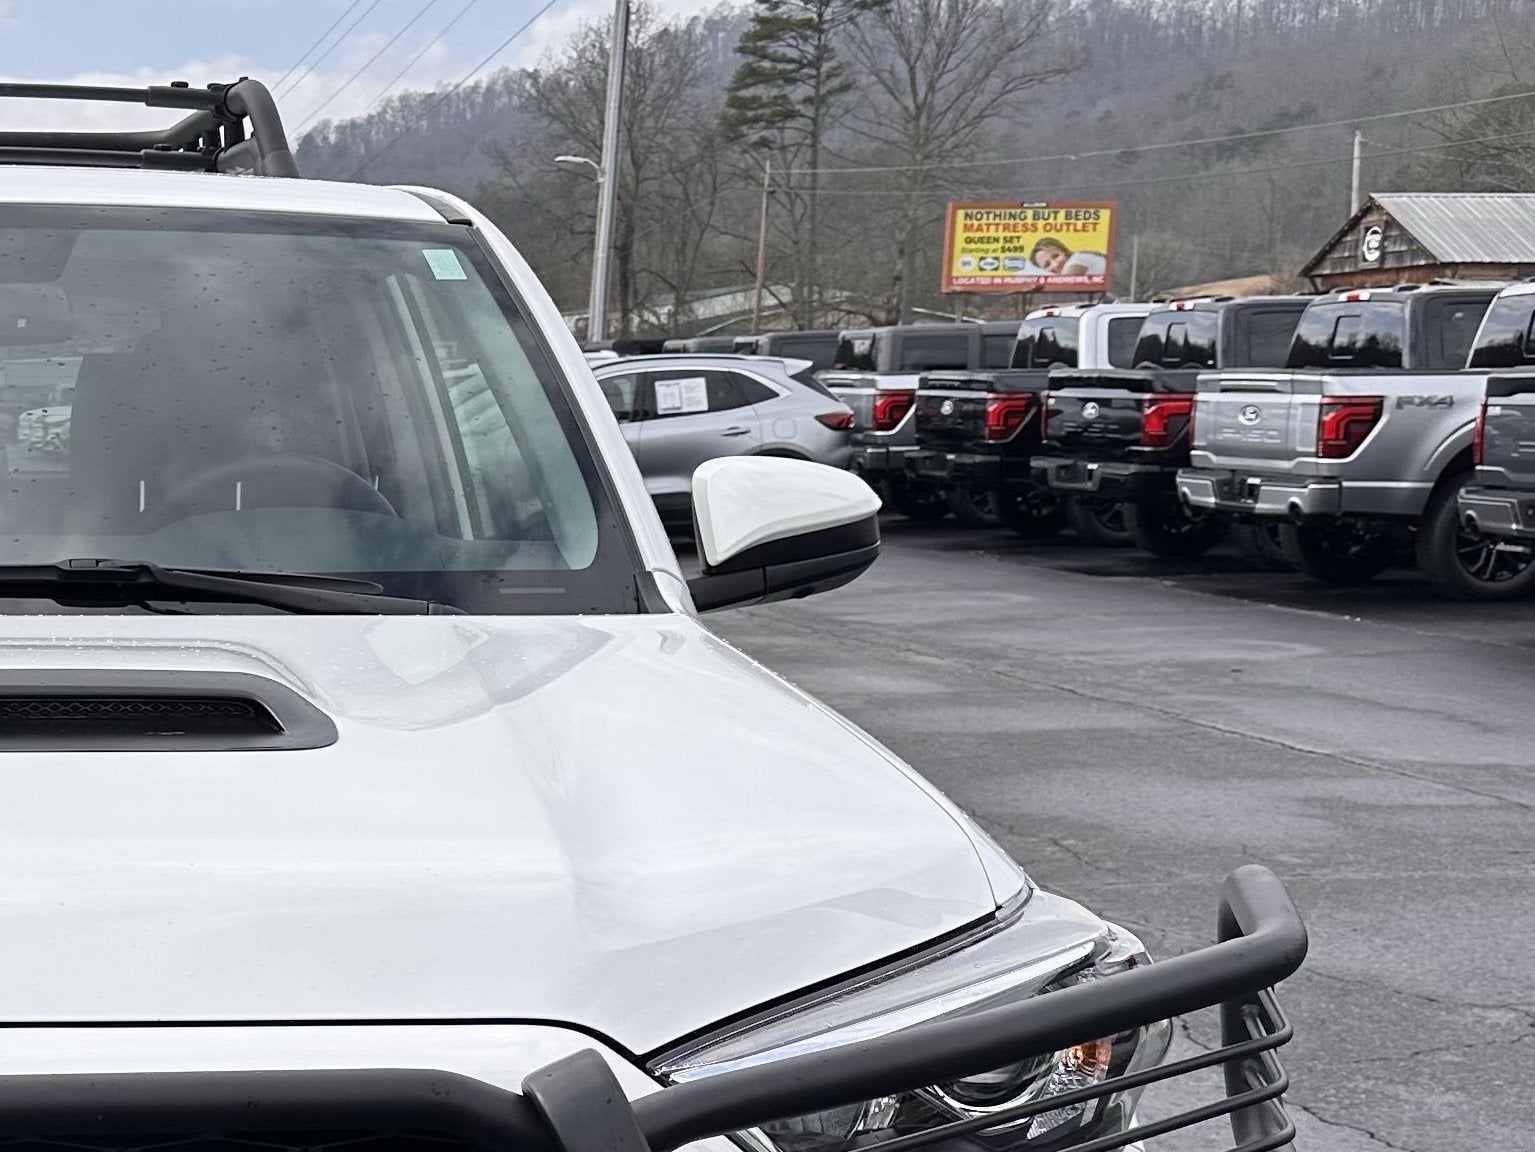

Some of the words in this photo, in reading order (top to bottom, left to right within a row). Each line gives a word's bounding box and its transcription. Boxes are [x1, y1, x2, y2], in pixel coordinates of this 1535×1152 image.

[964, 210, 1028, 221] NOTHING
[1032, 210, 1060, 221] BUT
[1065, 210, 1101, 221] BEDS
[963, 222, 1039, 233] MATTRESS
[1043, 222, 1100, 232] OUTLET
[964, 236, 1000, 245] QUEEN
[1003, 236, 1023, 245] SET
[1395, 395, 1455, 410] FX4
